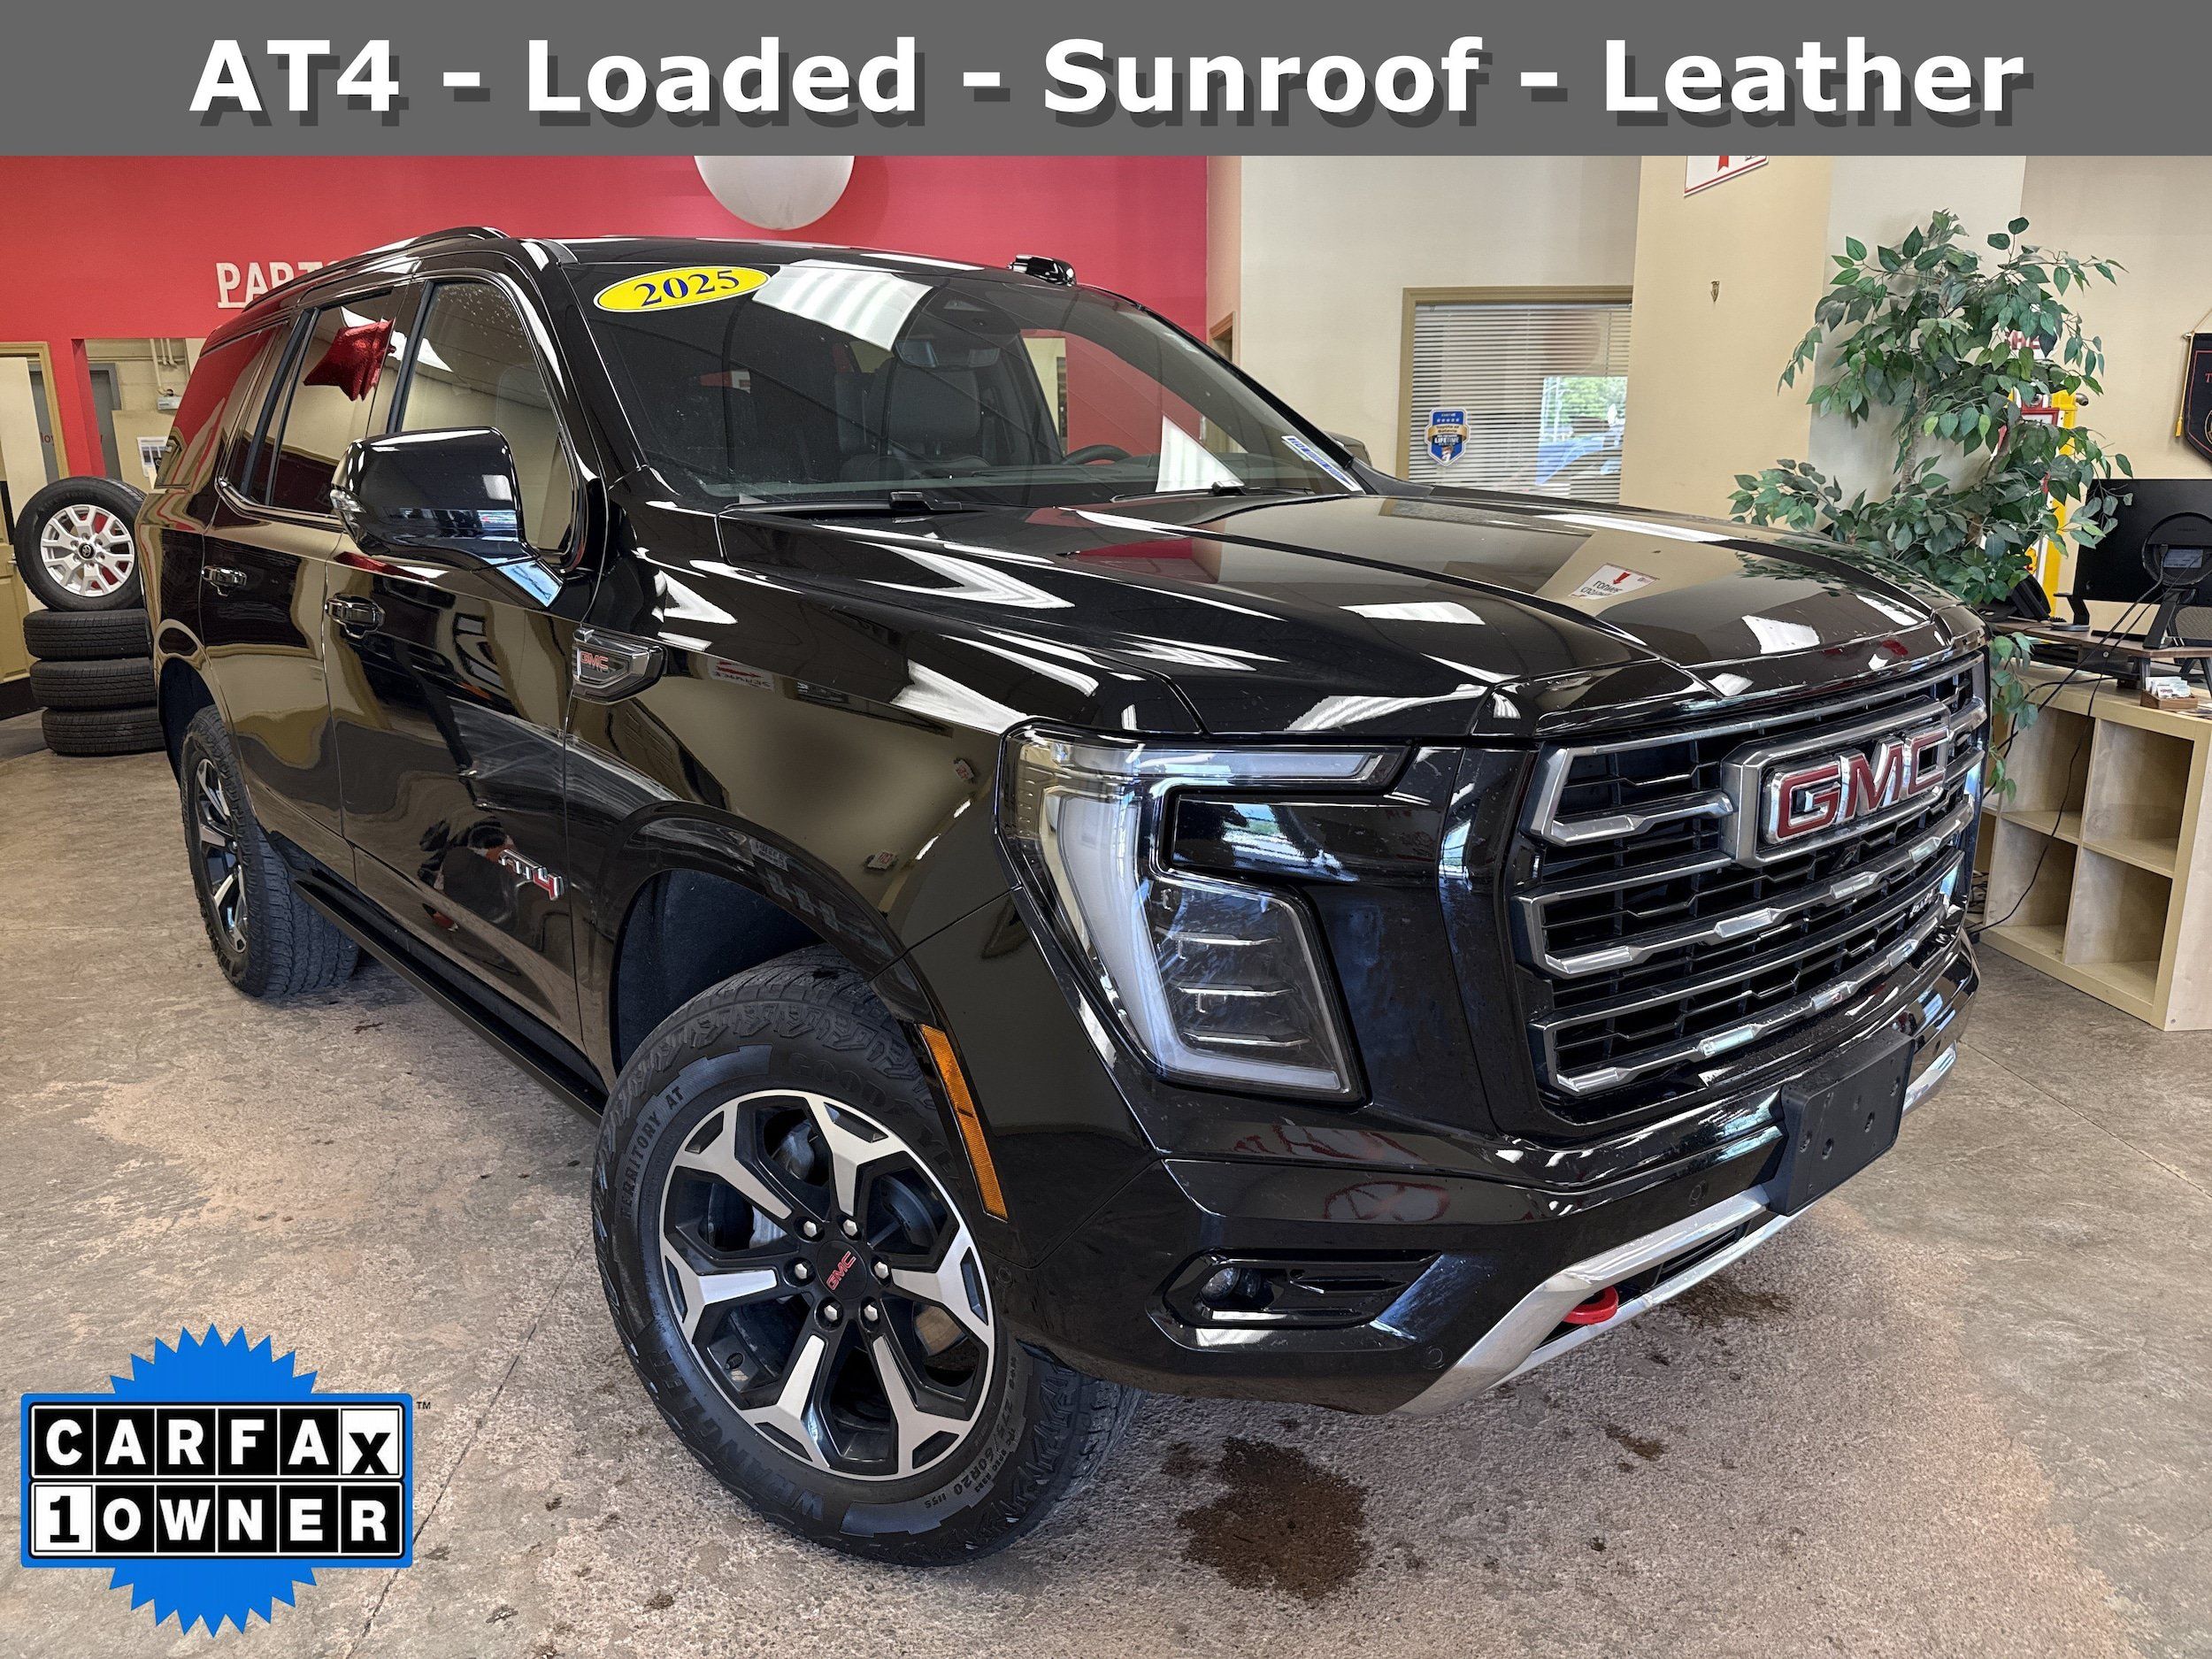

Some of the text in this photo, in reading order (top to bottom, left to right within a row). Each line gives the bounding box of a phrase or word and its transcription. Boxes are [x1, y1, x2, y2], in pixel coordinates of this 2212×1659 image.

[216, 260, 340, 306] PAR
[634, 269, 740, 307] 2025
[580, 650, 610, 672] GMC
[1770, 726, 1950, 841] GMC
[498, 849, 565, 901] AT4
[619, 1086, 685, 1219] TERRITORY AT
[826, 1250, 857, 1291] GMC
[649, 1346, 826, 1522] WRANGLER
